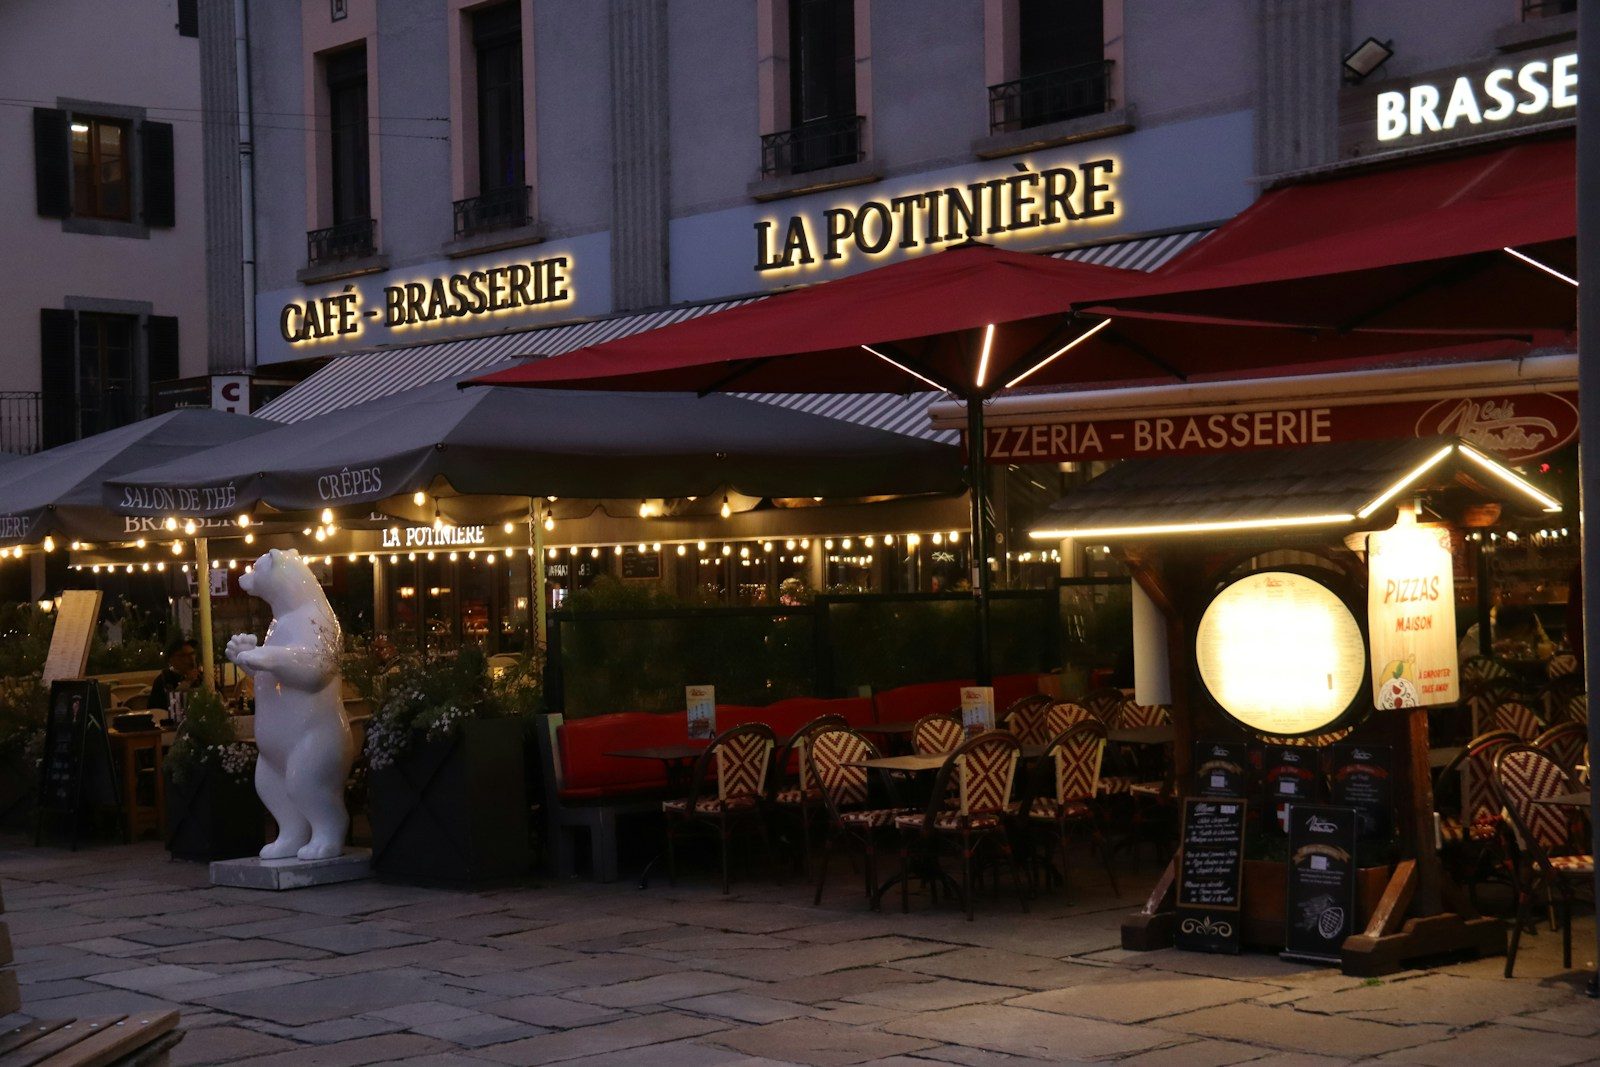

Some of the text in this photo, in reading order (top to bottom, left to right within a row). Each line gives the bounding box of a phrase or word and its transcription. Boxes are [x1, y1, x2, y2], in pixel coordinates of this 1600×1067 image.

[1377, 53, 1578, 141] BRASSE
[754, 158, 1115, 271] LA POTINIÈRE
[279, 284, 358, 343] CAFÉ
[384, 257, 568, 328] BRASSERIE
[964, 422, 1104, 458] IZZERIA
[1134, 408, 1332, 452] BRASSERIE
[119, 481, 237, 511] SALON DE THÉ
[317, 466, 383, 501] CRÊPES
[382, 528, 401, 547] LA
[1384, 575, 1440, 604] PIZZAS
[1395, 614, 1433, 633] MAISON
